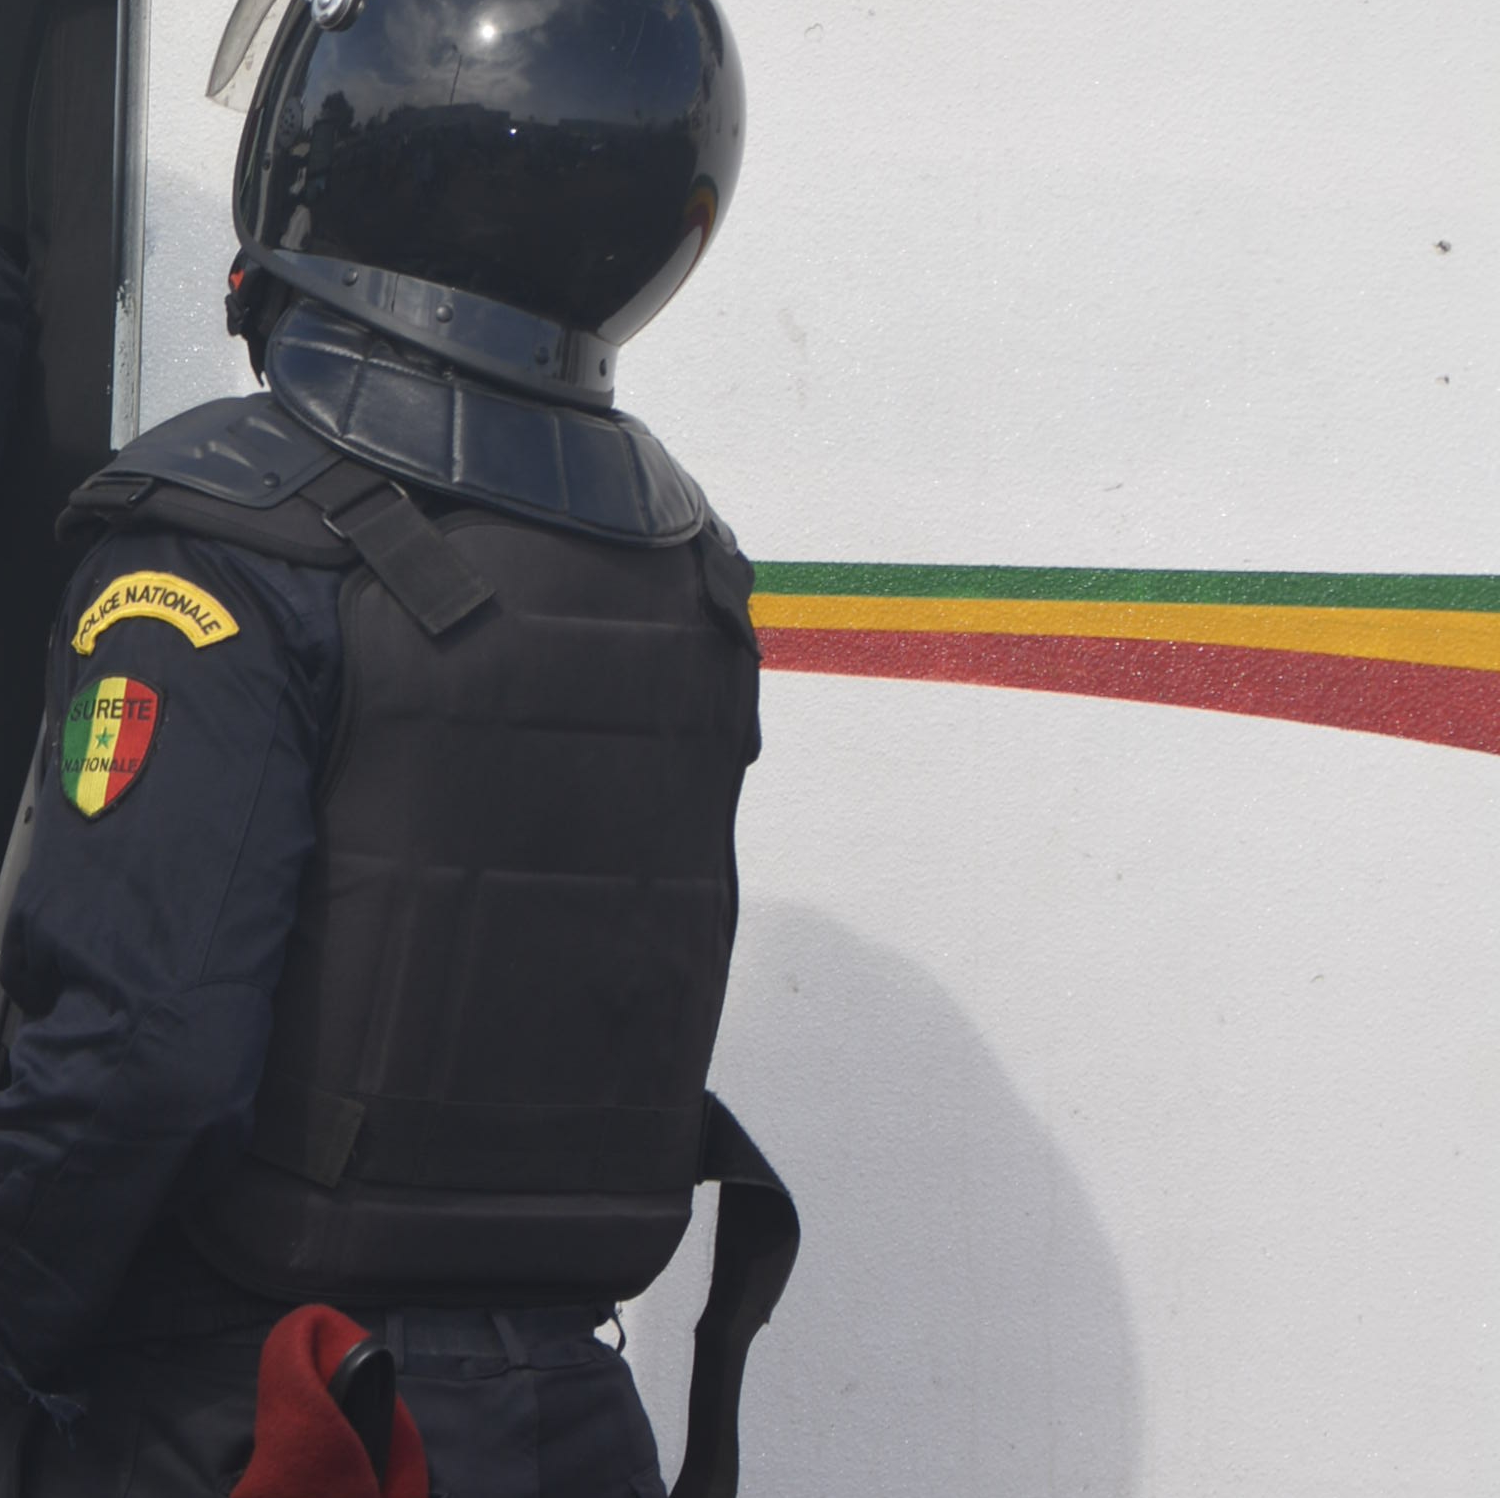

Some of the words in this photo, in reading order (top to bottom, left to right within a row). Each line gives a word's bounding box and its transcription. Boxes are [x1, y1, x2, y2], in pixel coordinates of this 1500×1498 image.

[124, 584, 222, 636] NATIONALE
[70, 698, 152, 721] SURETE
[62, 757, 140, 774] NATIONALE
